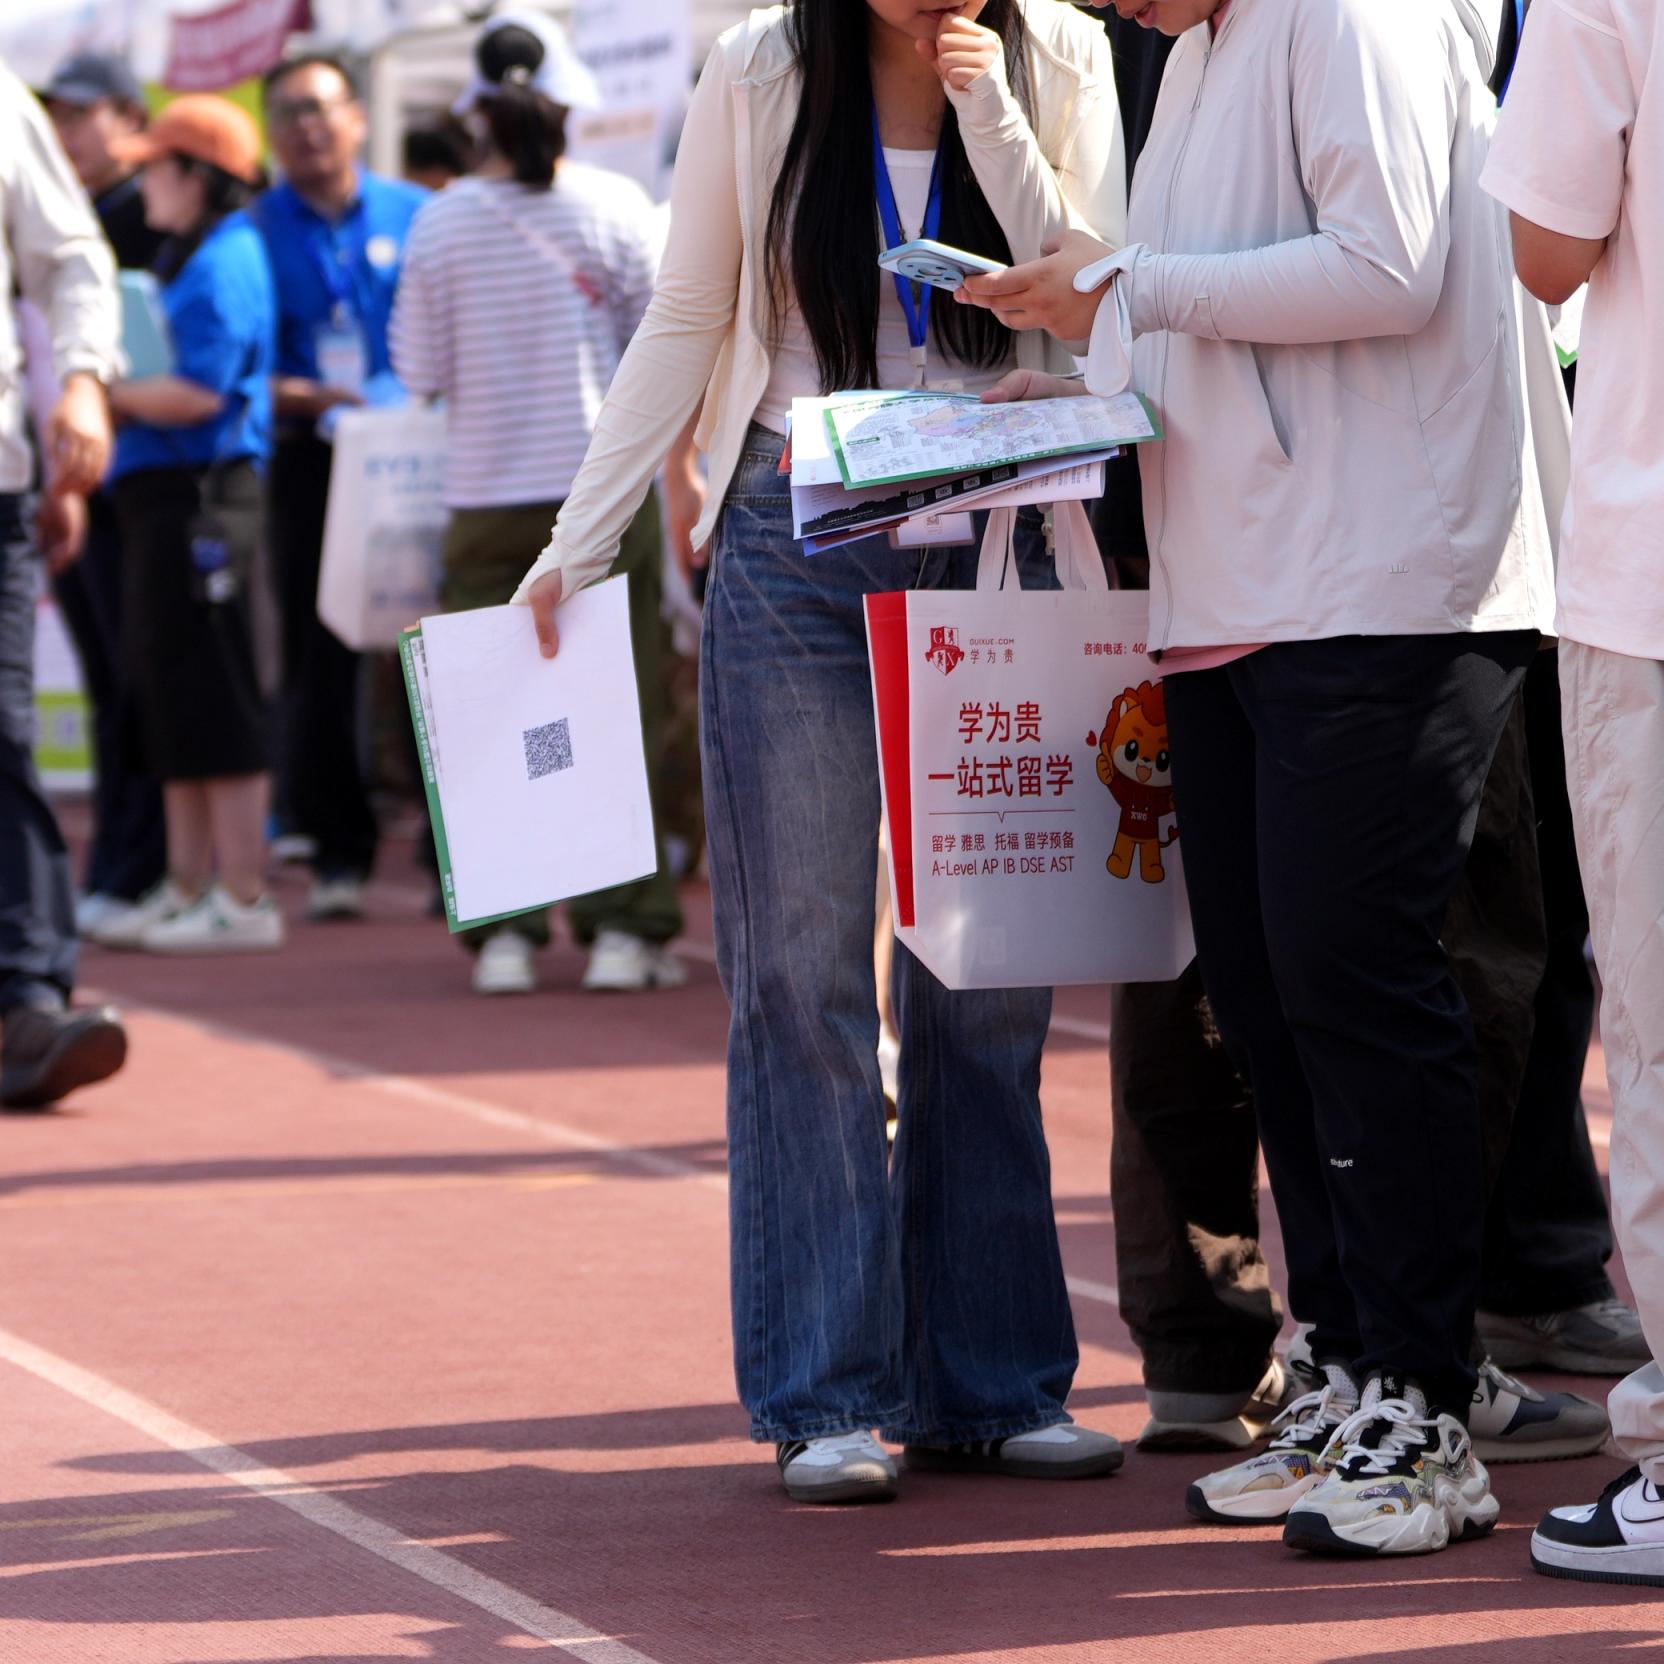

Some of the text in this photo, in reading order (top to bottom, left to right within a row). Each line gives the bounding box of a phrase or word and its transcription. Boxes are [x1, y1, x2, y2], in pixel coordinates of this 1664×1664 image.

[958, 701, 1042, 744] 学为贵
[928, 755, 1074, 798] 一站式留学
[932, 831, 1074, 852] 留学 雅思 托福 留学预备
[932, 856, 1074, 876] A-Level AP IB DSE AST
